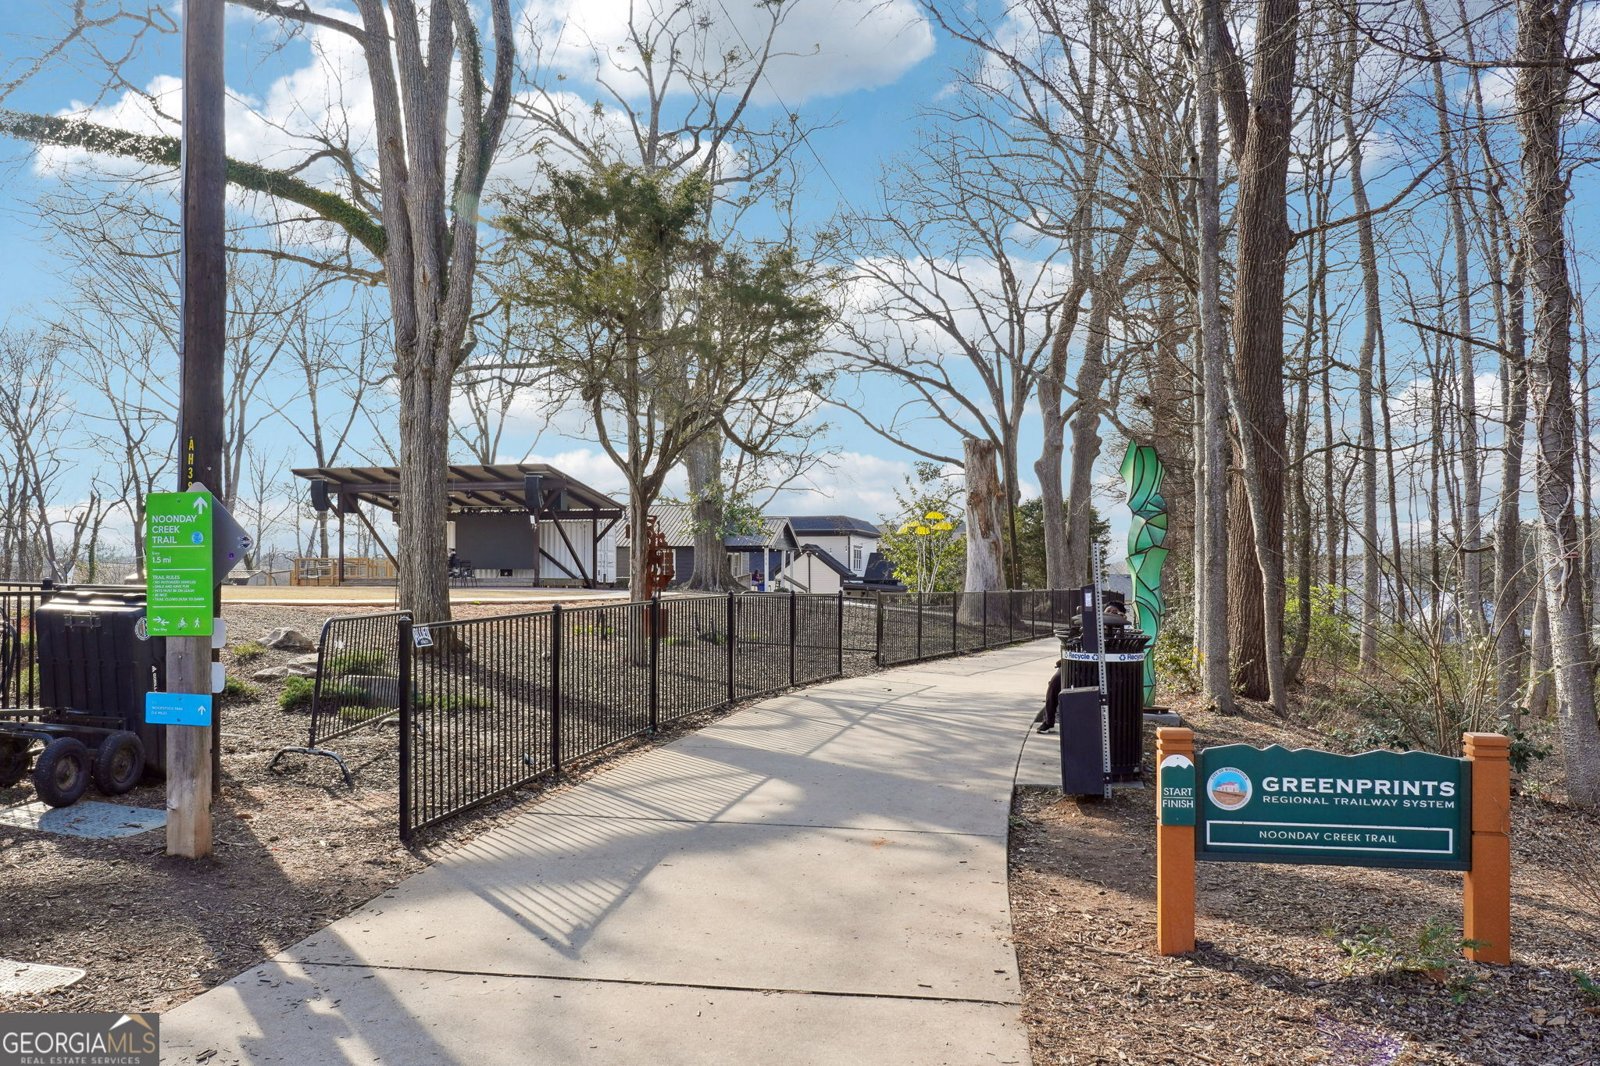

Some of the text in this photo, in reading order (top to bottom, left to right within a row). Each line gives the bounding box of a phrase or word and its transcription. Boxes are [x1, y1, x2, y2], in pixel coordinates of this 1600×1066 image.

[1164, 788, 1192, 796] START
[1262, 777, 1455, 796] GREENPRINTS
[1163, 800, 1194, 808] FINISH
[1263, 796, 1455, 808] REGIONAL TRAILWAY SYSTEM
[1259, 831, 1397, 843] NOONDAY CREEK TRAIL
